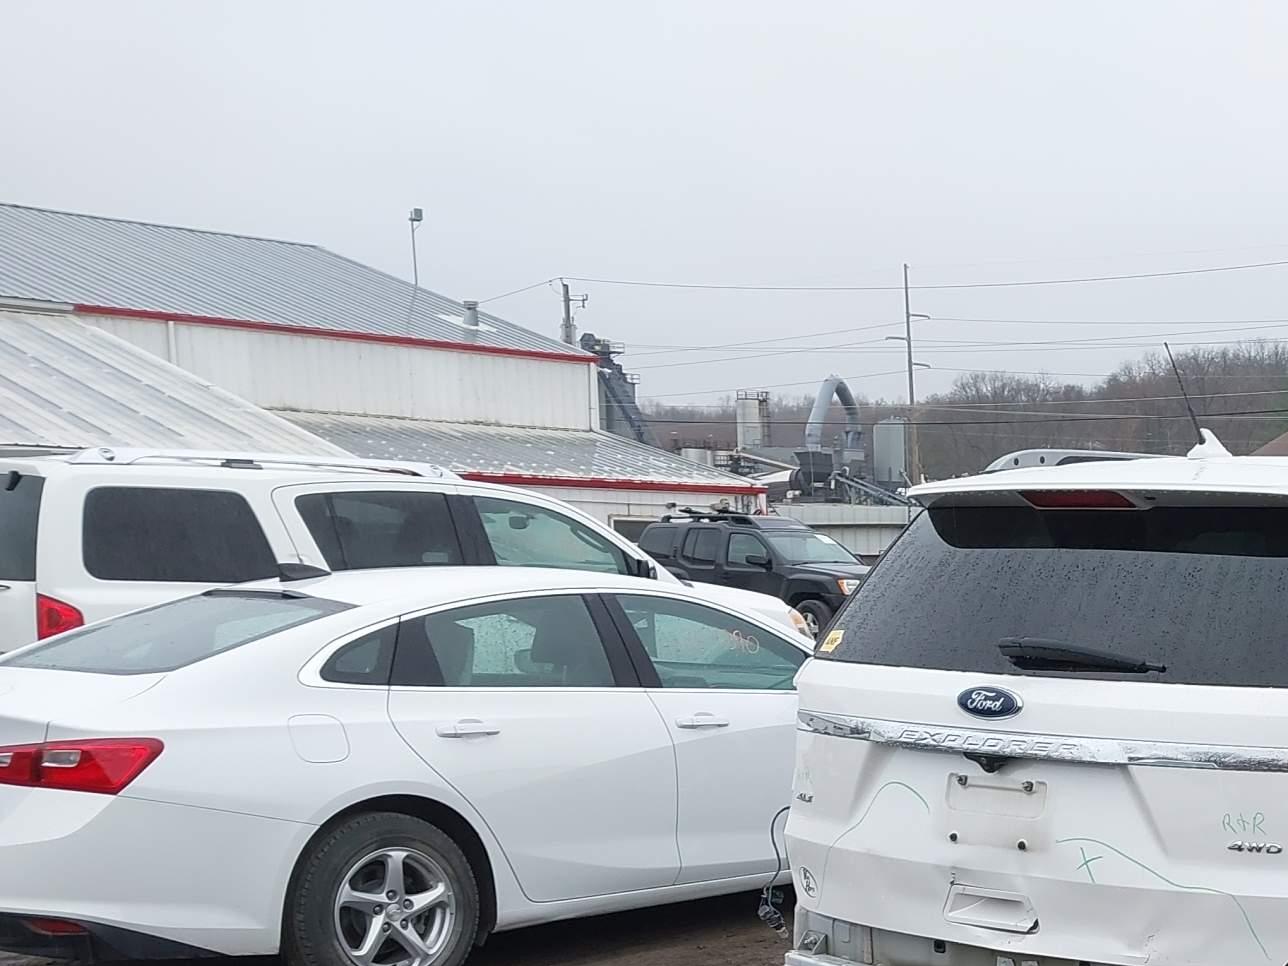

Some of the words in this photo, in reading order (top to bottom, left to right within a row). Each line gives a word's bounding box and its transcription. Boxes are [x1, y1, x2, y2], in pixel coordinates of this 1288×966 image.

[967, 690, 1005, 712] Ford
[899, 729, 1082, 757] EXPLORER
[1227, 841, 1283, 855] 4WD
